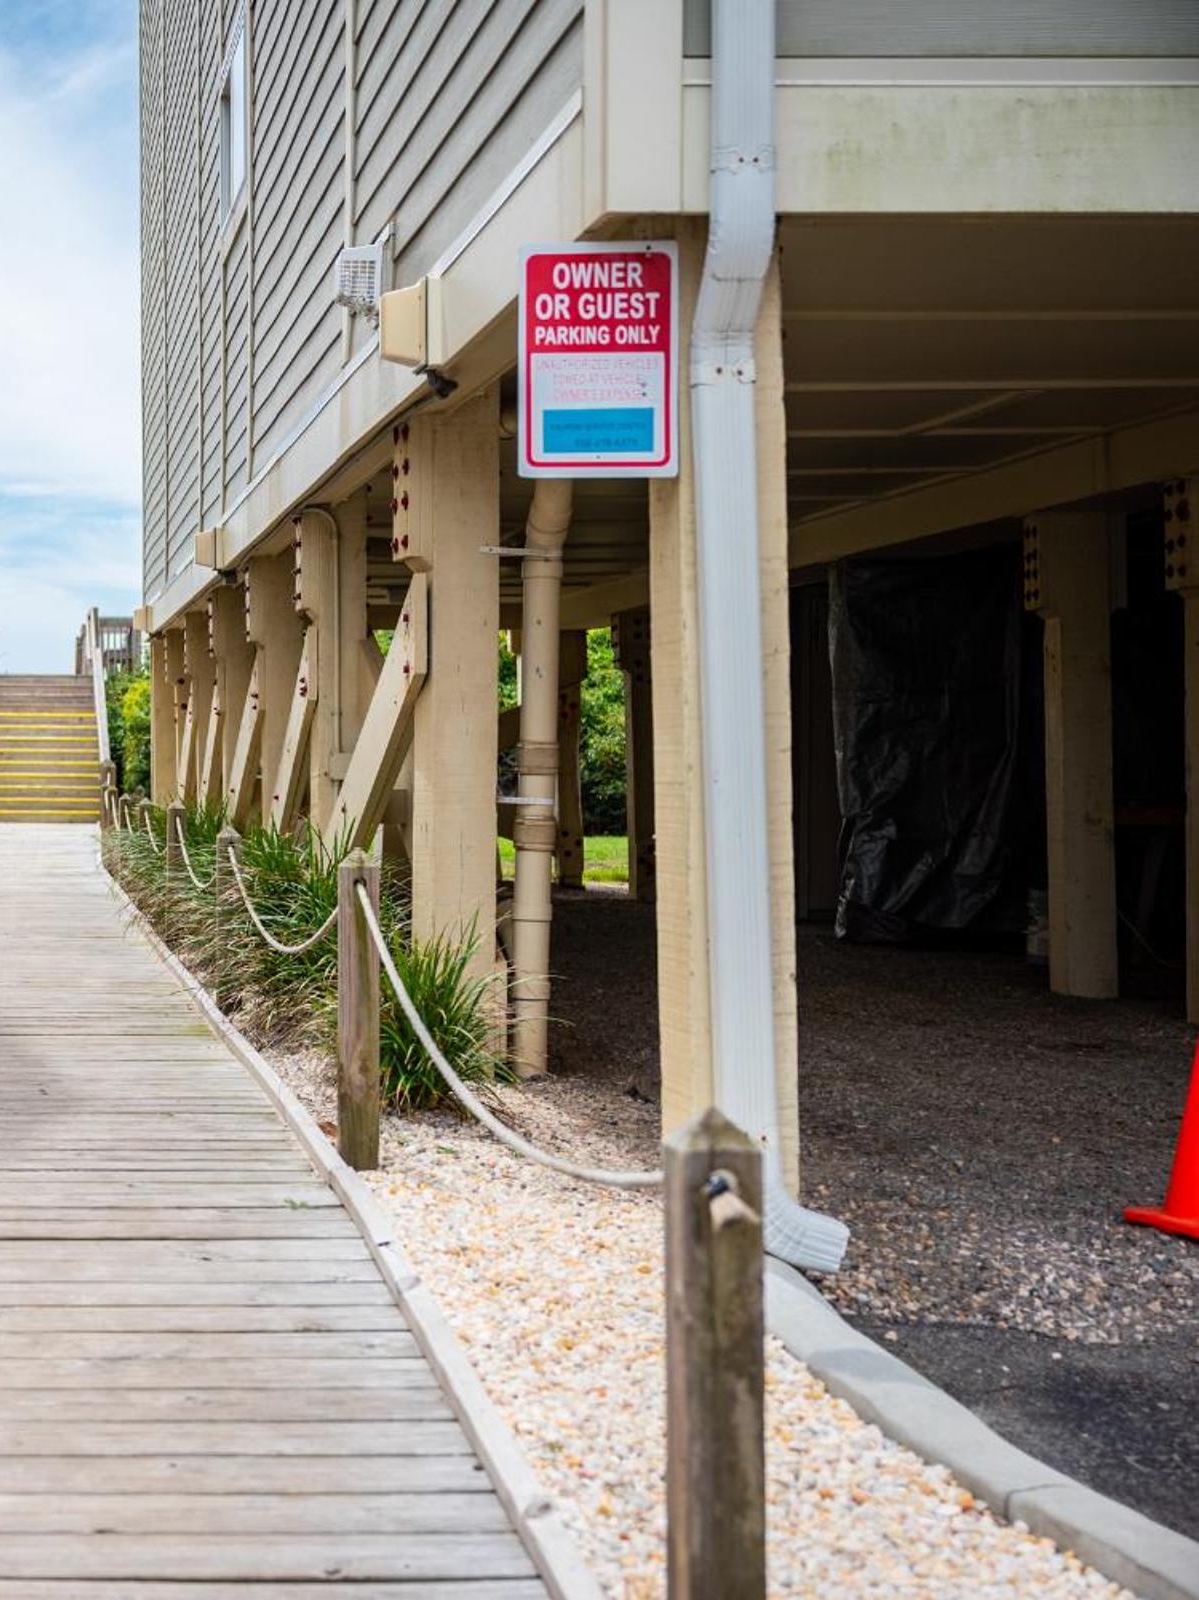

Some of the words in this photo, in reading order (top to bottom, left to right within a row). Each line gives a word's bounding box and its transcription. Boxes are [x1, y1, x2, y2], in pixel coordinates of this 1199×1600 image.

[553, 262, 644, 289] OWNER
[535, 293, 571, 321] OR
[578, 292, 660, 320] GUEST
[535, 326, 611, 346] PARKING
[615, 325, 661, 345] ONLY
